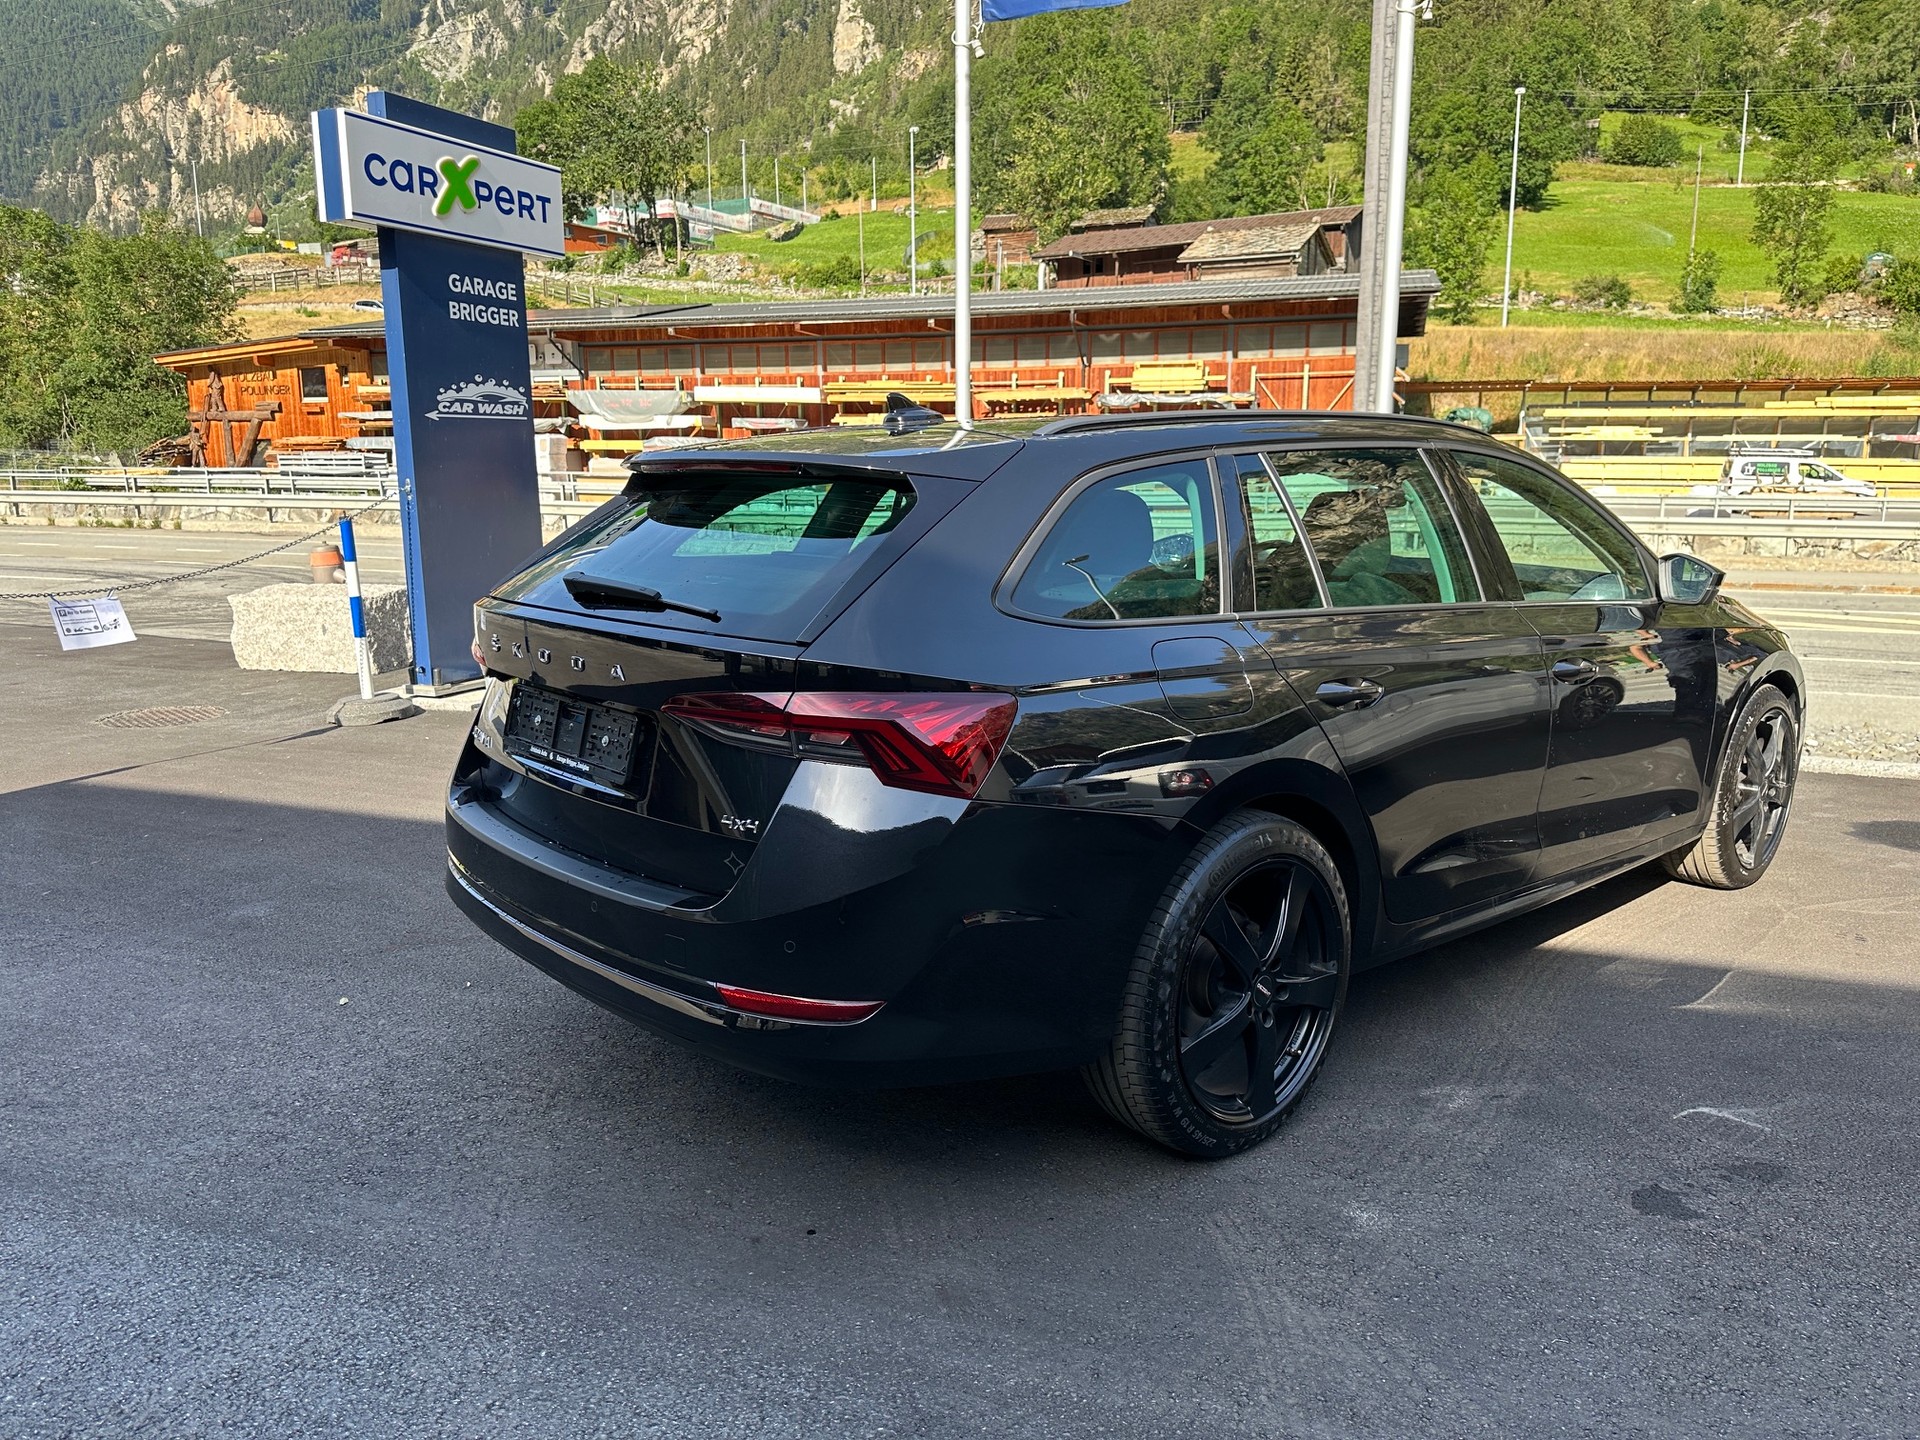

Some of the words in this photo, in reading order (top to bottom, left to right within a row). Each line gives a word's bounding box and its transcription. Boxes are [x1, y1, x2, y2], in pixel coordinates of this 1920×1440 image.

[448, 273, 517, 301] GARAGE
[448, 301, 520, 327] BRIGGER
[438, 401, 474, 413] CAR
[477, 403, 524, 415] WASH
